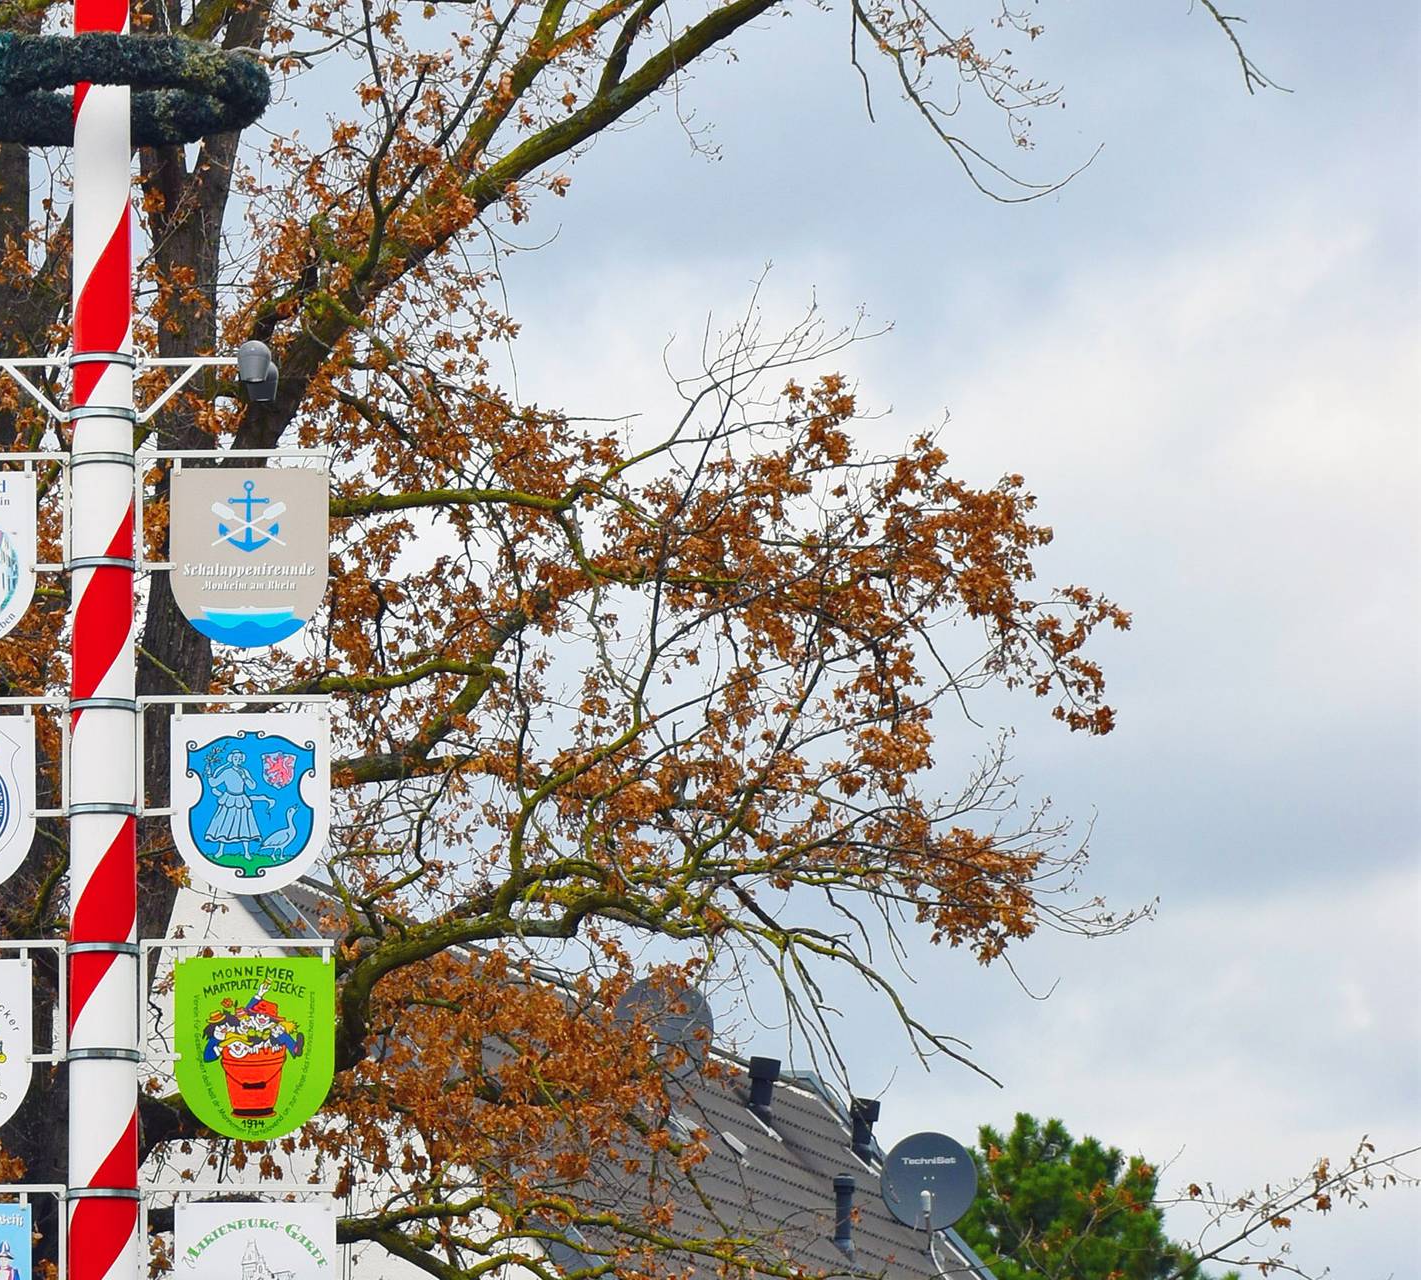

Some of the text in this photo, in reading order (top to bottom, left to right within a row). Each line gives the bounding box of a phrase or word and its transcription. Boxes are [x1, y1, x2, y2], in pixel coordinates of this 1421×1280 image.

[201, 580, 297, 591] Monheim am Rhein
[212, 966, 294, 982] MONNEMER
[272, 980, 306, 998] JECKE
[241, 1119, 265, 1129] 1974
[901, 1156, 957, 1165] TechniSat
